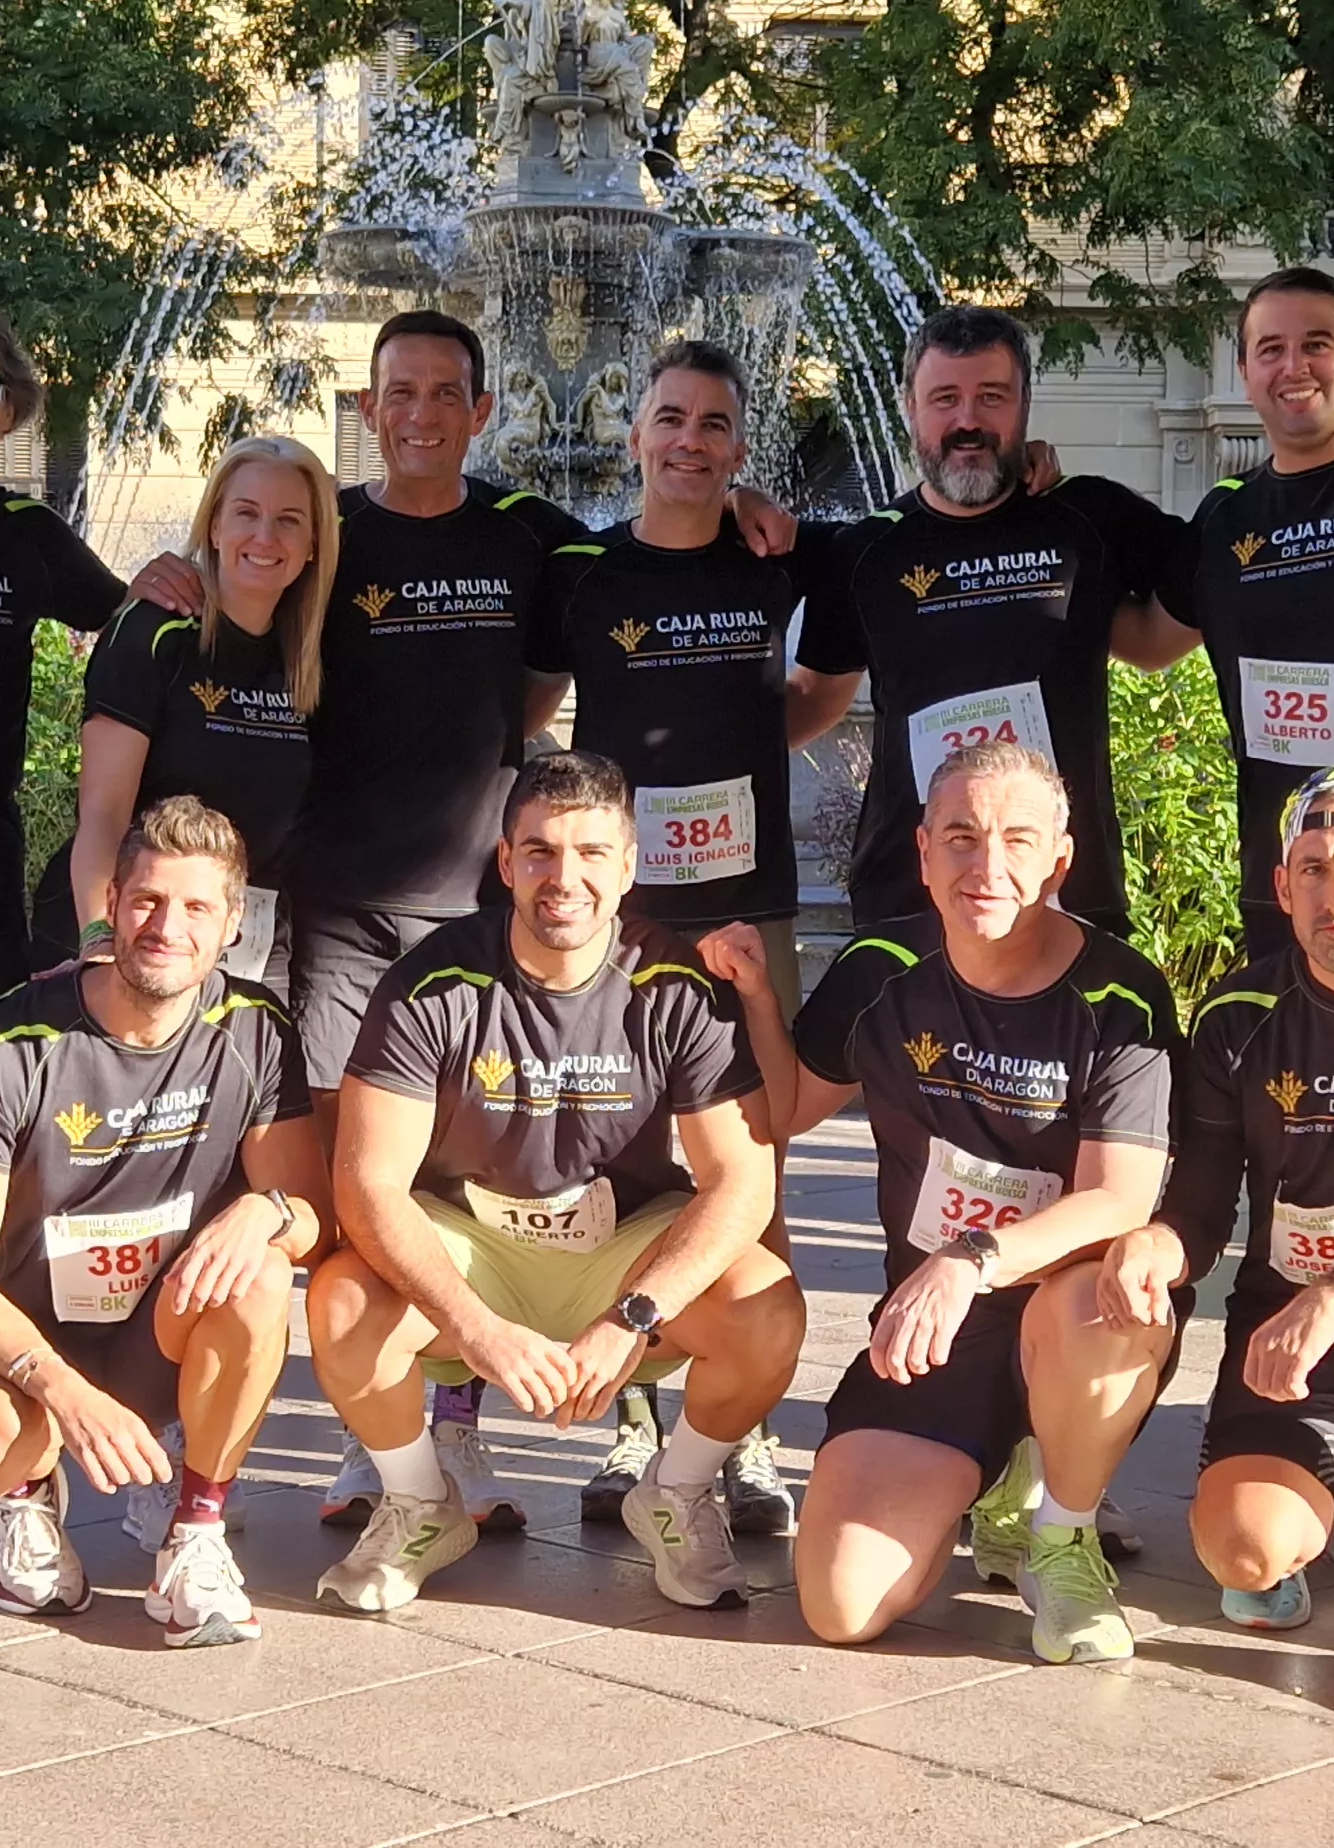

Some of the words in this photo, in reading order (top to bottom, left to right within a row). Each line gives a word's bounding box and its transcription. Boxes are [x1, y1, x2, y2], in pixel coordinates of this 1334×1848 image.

[1270, 521, 1316, 545] CAJA
[1280, 543, 1301, 559] DE
[945, 558, 994, 578] CAJA
[998, 549, 1063, 572] RURAL
[401, 580, 452, 598] CAJA
[455, 579, 512, 596] RURAL
[959, 578, 981, 591] DE
[985, 567, 1051, 588] ARAGÓN
[417, 602, 438, 614] DE
[443, 597, 504, 612] ARAGÓN
[370, 624, 402, 635] FONDO
[403, 623, 414, 632] DE
[656, 613, 706, 633] CAJA
[710, 609, 768, 629] RURAL
[672, 634, 693, 648] DE
[698, 628, 762, 646] ARAGÓN
[627, 658, 658, 670] FONDO
[230, 687, 265, 707] CAJA
[952, 696, 1010, 715] CARRERA
[1264, 690, 1328, 723] 325
[243, 707, 258, 721] DE
[1264, 722, 1332, 740] ALBERTO
[1273, 738, 1291, 754] 8K
[678, 790, 729, 805] CARRERA
[665, 813, 733, 848] 384
[645, 853, 682, 865] LUIS
[688, 842, 751, 864] IGNACIO
[675, 866, 699, 881] 8K
[521, 1058, 563, 1079] CAJA
[562, 1054, 631, 1074] RURAL
[1000, 1056, 1070, 1082] RURAL
[151, 1085, 210, 1114] RURAL
[530, 1083, 553, 1098] DE
[982, 1080, 1054, 1099] ARAGÓN
[1004, 1106, 1011, 1115] Y
[137, 1109, 200, 1133] ARAGÓN
[70, 1156, 103, 1167] FONDO
[966, 1167, 1029, 1192] CARRERA
[940, 1186, 1023, 1231] 326
[501, 1209, 579, 1230] 107
[501, 1224, 586, 1241] ALBERTO
[87, 1237, 160, 1277] 381
[108, 1273, 149, 1294] LUIS
[100, 1296, 128, 1311] 8K
